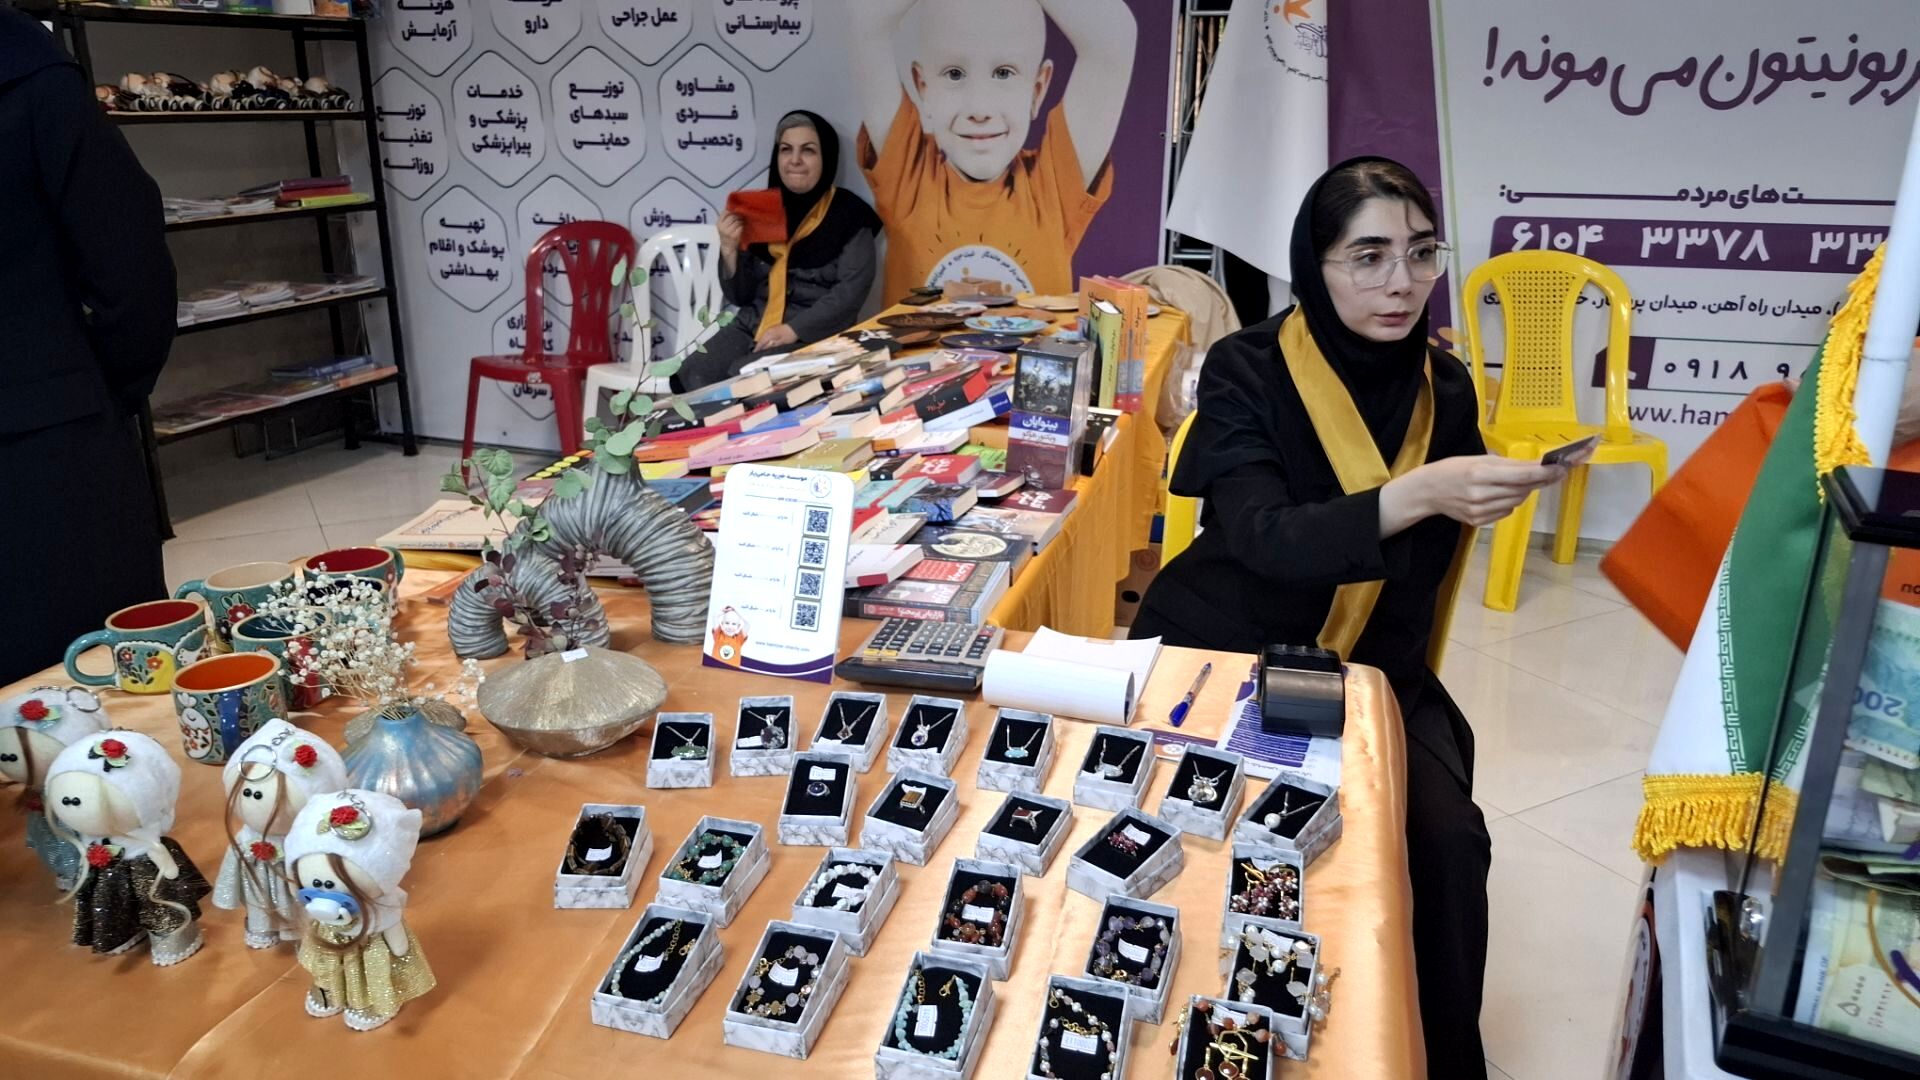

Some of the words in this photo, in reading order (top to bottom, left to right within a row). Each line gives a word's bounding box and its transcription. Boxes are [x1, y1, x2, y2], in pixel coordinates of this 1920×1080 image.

[525, 15, 549, 34] دارو
[612, 8, 648, 27] جراحی
[651, 8, 678, 27] عمل
[725, 15, 801, 34] بیمارستانی
[402, 20, 457, 41] آزمایش
[1698, 33, 1920, 111] ربونیتون
[467, 84, 523, 98] خدمات
[569, 81, 624, 99] توزیع
[676, 76, 735, 96] مشاوره
[376, 104, 426, 121] توزیع
[469, 114, 476, 127] و
[479, 109, 527, 132] پزشکی
[570, 106, 628, 124] سبدهای
[676, 105, 738, 123] فردی
[379, 128, 432, 147] تغذیه
[472, 134, 531, 157] پیراپزشکی
[573, 133, 630, 150] حمایتی
[678, 132, 733, 149] تحصیلی
[383, 157, 434, 174] روزانه
[440, 217, 485, 233] تهیه
[644, 208, 707, 227] آموزش
[430, 239, 455, 254] اقلام
[459, 245, 465, 257] و
[467, 239, 504, 261] پوشک
[1640, 226, 1770, 262] ۳۳۷۸
[1810, 231, 1883, 265] ۳۳
[440, 263, 498, 281] بهداشتی
[1650, 294, 1697, 313] میدان
[1749, 298, 1767, 316] راه
[1772, 299, 1822, 318] میدان
[513, 384, 547, 397] سرطان
[1022, 415, 1058, 431] بینوایان
